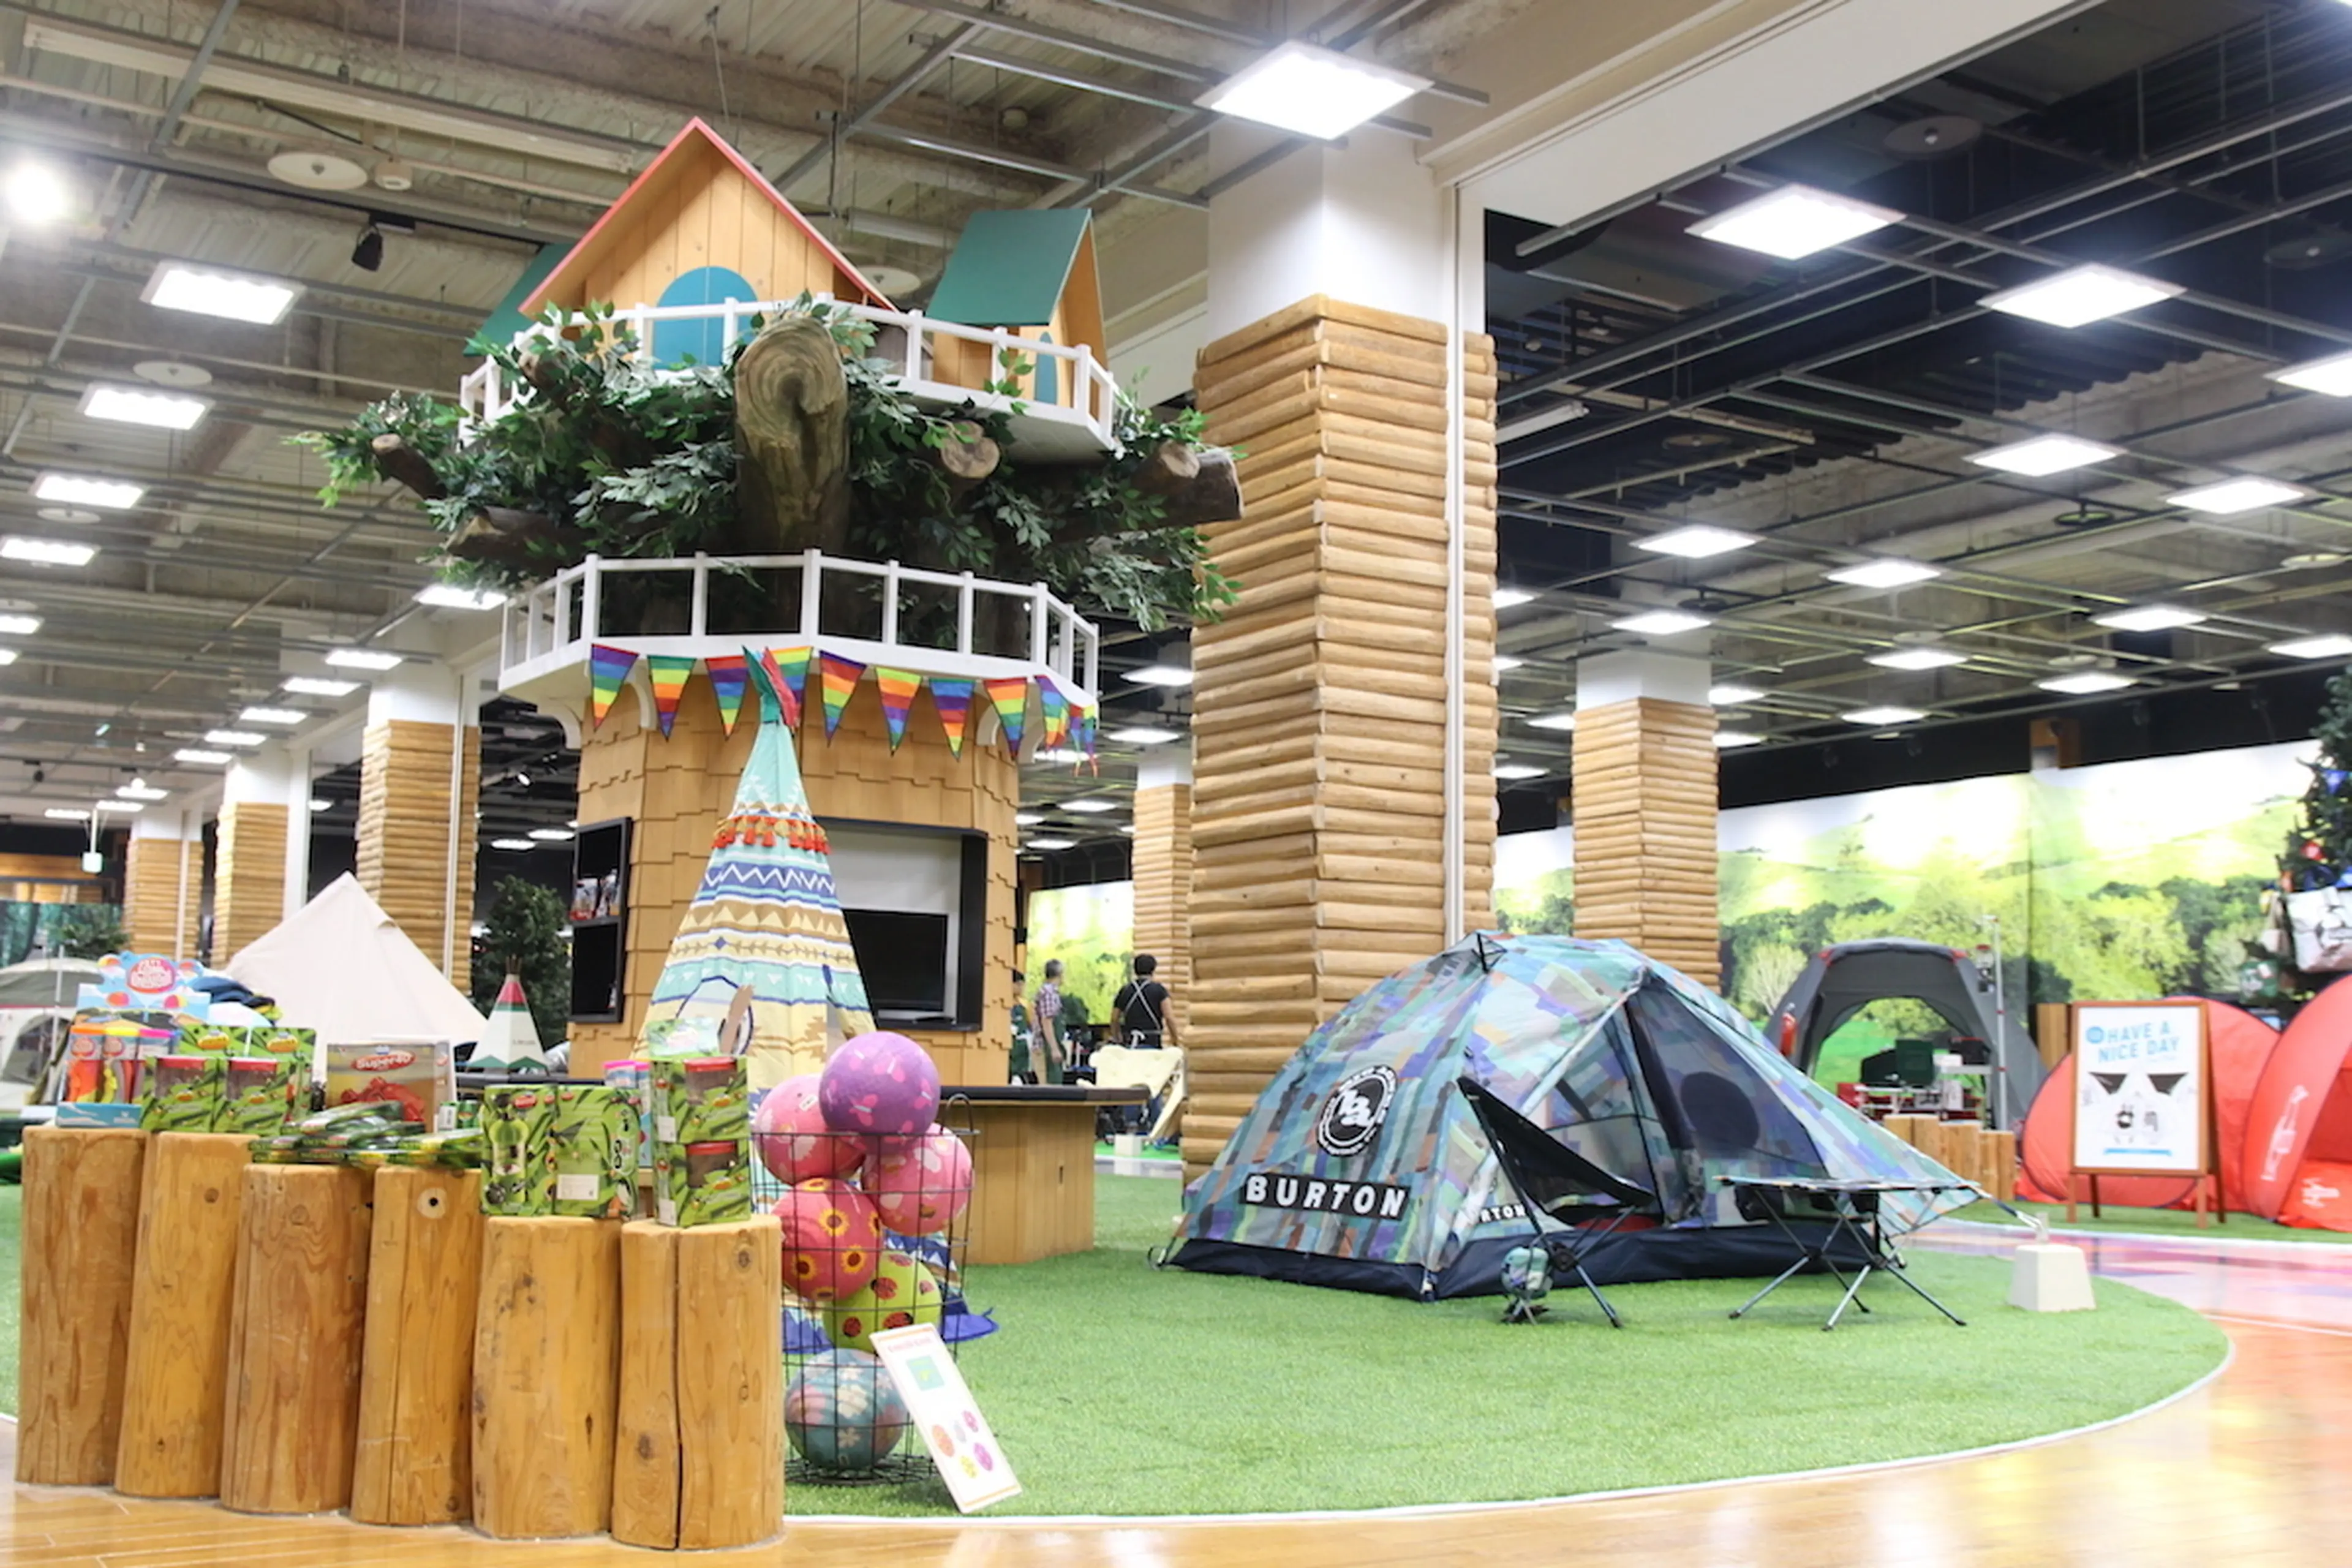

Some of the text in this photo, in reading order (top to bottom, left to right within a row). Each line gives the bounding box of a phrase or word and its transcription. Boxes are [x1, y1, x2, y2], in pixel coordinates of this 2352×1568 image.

[2108, 1020, 2171, 1043] HAVE A
[2098, 1036, 2180, 1063] NICE DAY
[1245, 1175, 1406, 1218] BURTON
[1480, 1204, 1526, 1223] RTON
